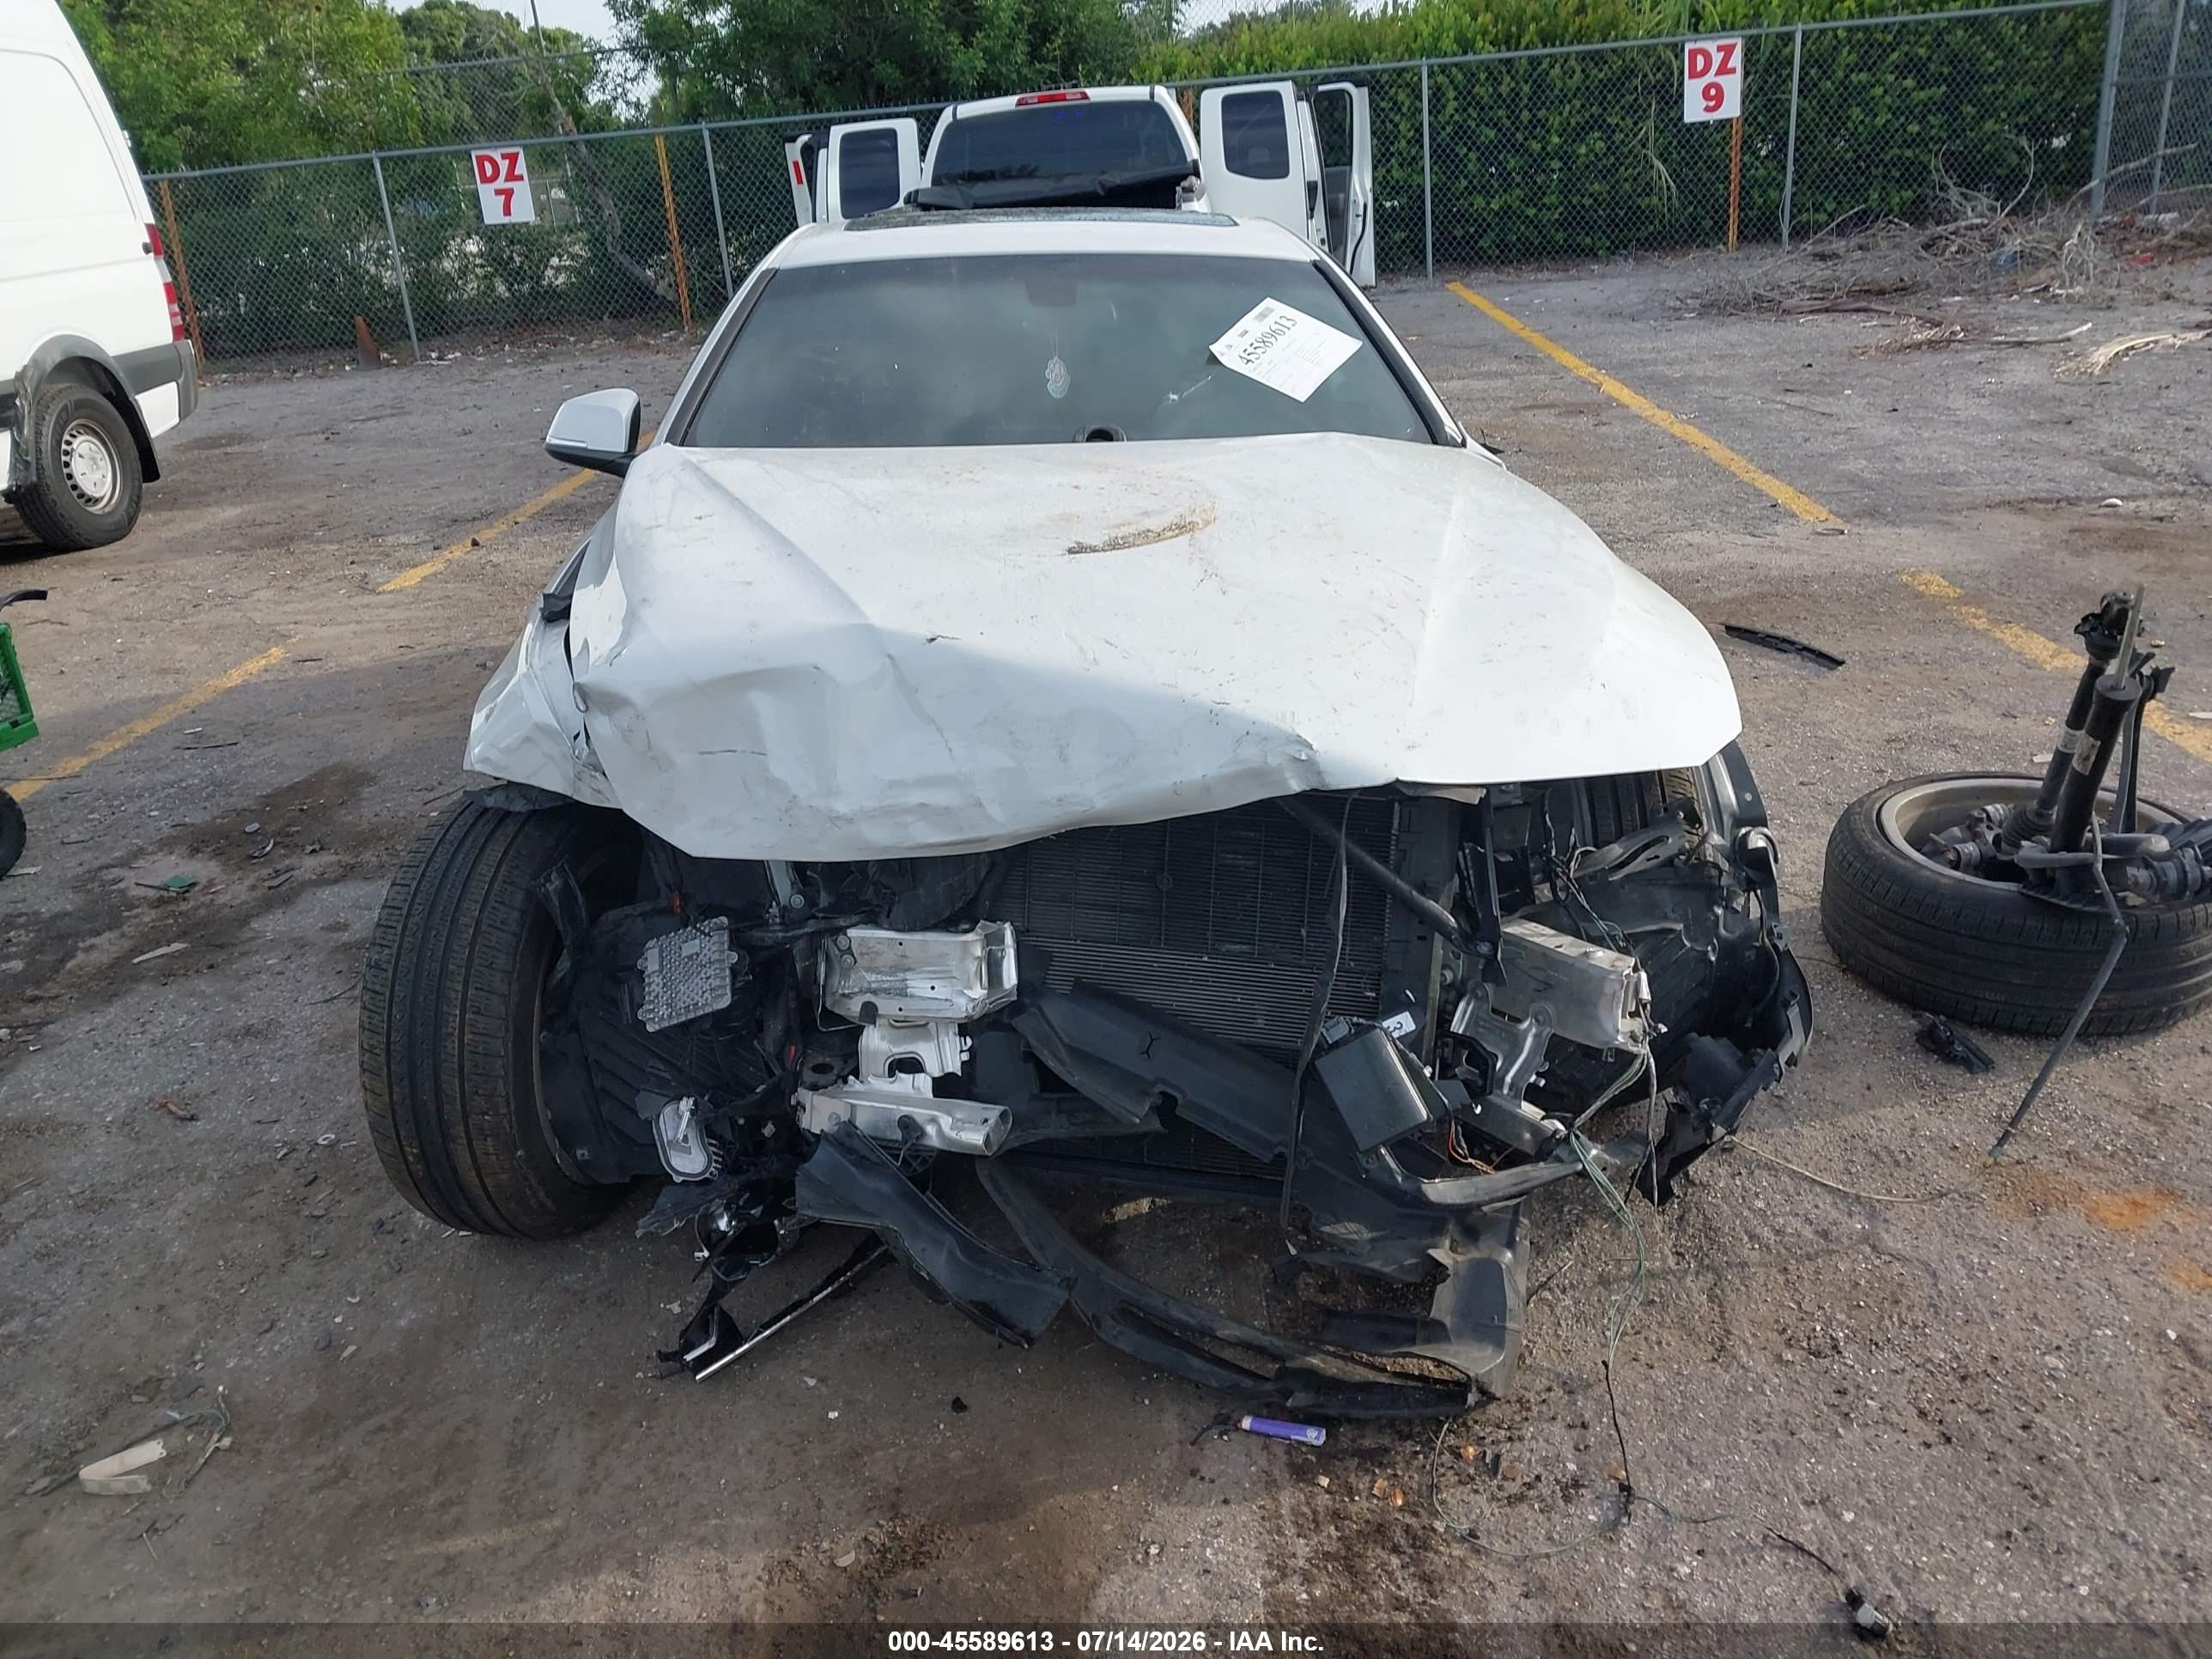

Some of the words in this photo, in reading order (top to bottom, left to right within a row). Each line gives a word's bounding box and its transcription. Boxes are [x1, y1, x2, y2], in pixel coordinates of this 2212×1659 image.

[1687, 43, 1739, 80] DZ
[1701, 82, 1725, 112] 9
[474, 151, 525, 184] DZ
[493, 187, 515, 216] 7
[1237, 315, 1297, 366] 45589613
